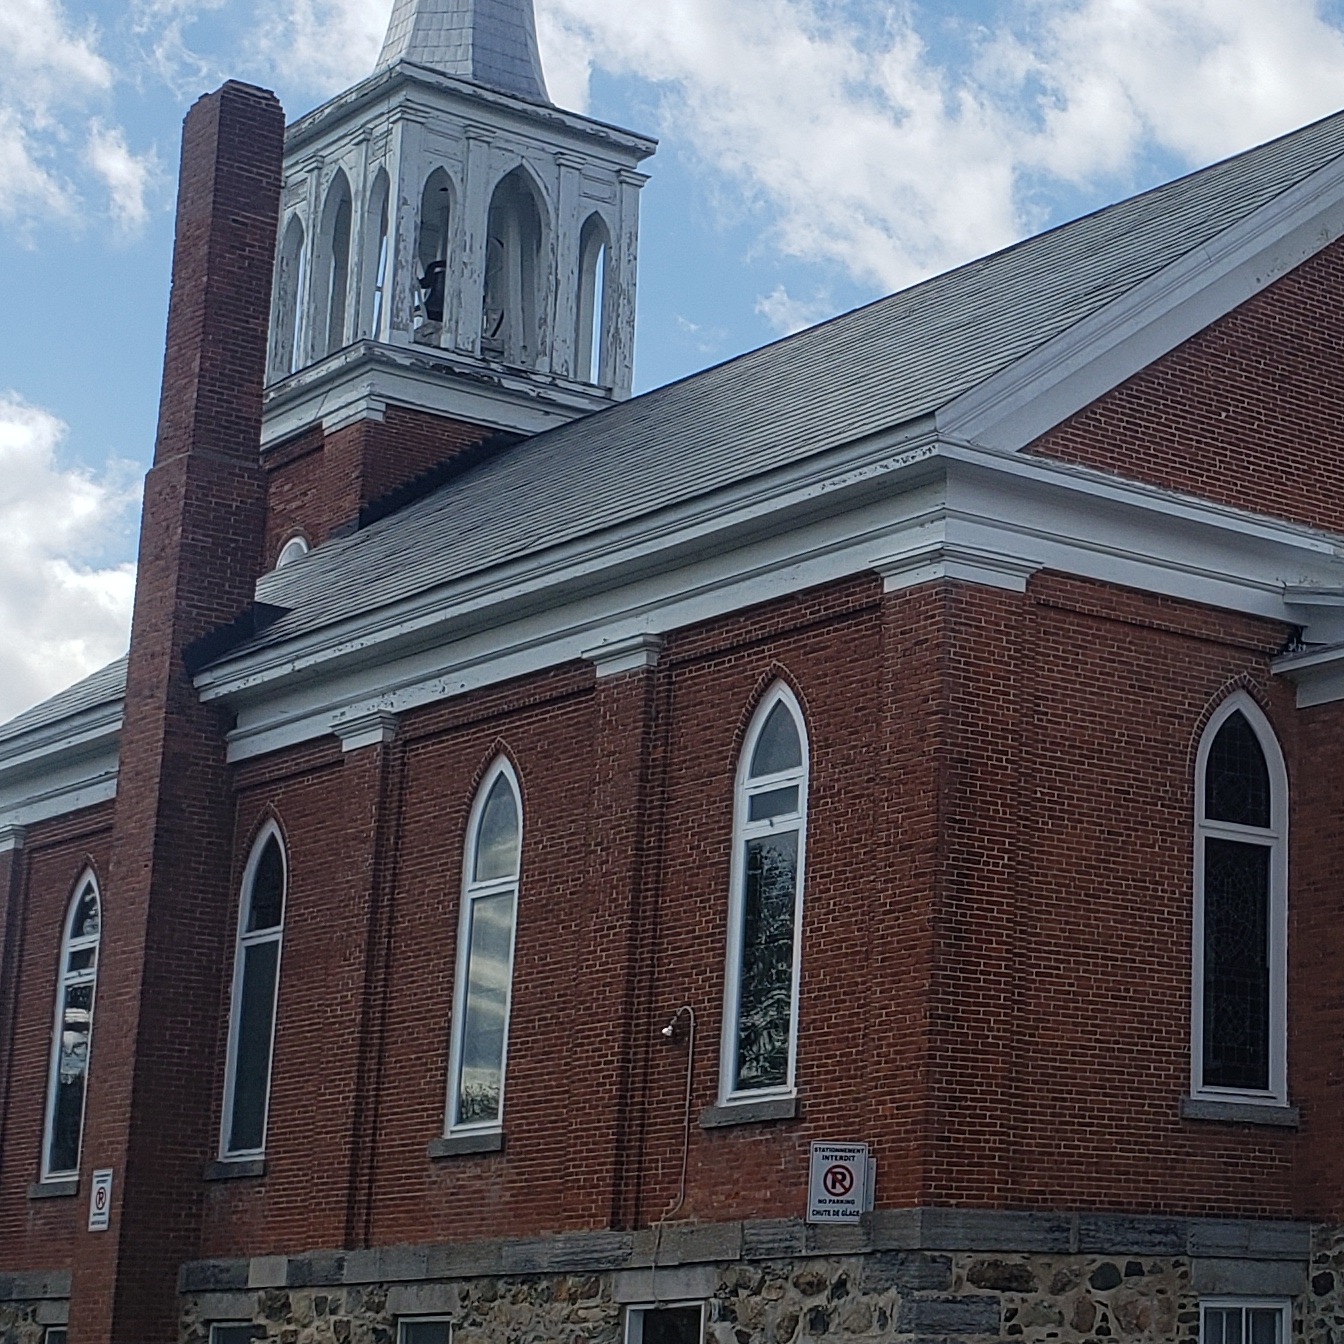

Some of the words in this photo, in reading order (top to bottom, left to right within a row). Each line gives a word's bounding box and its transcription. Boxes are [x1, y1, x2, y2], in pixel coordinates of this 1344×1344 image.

[812, 1209, 831, 1217] CHUTE
[832, 1209, 840, 1217] DE
[841, 1208, 860, 1217] GLACE
